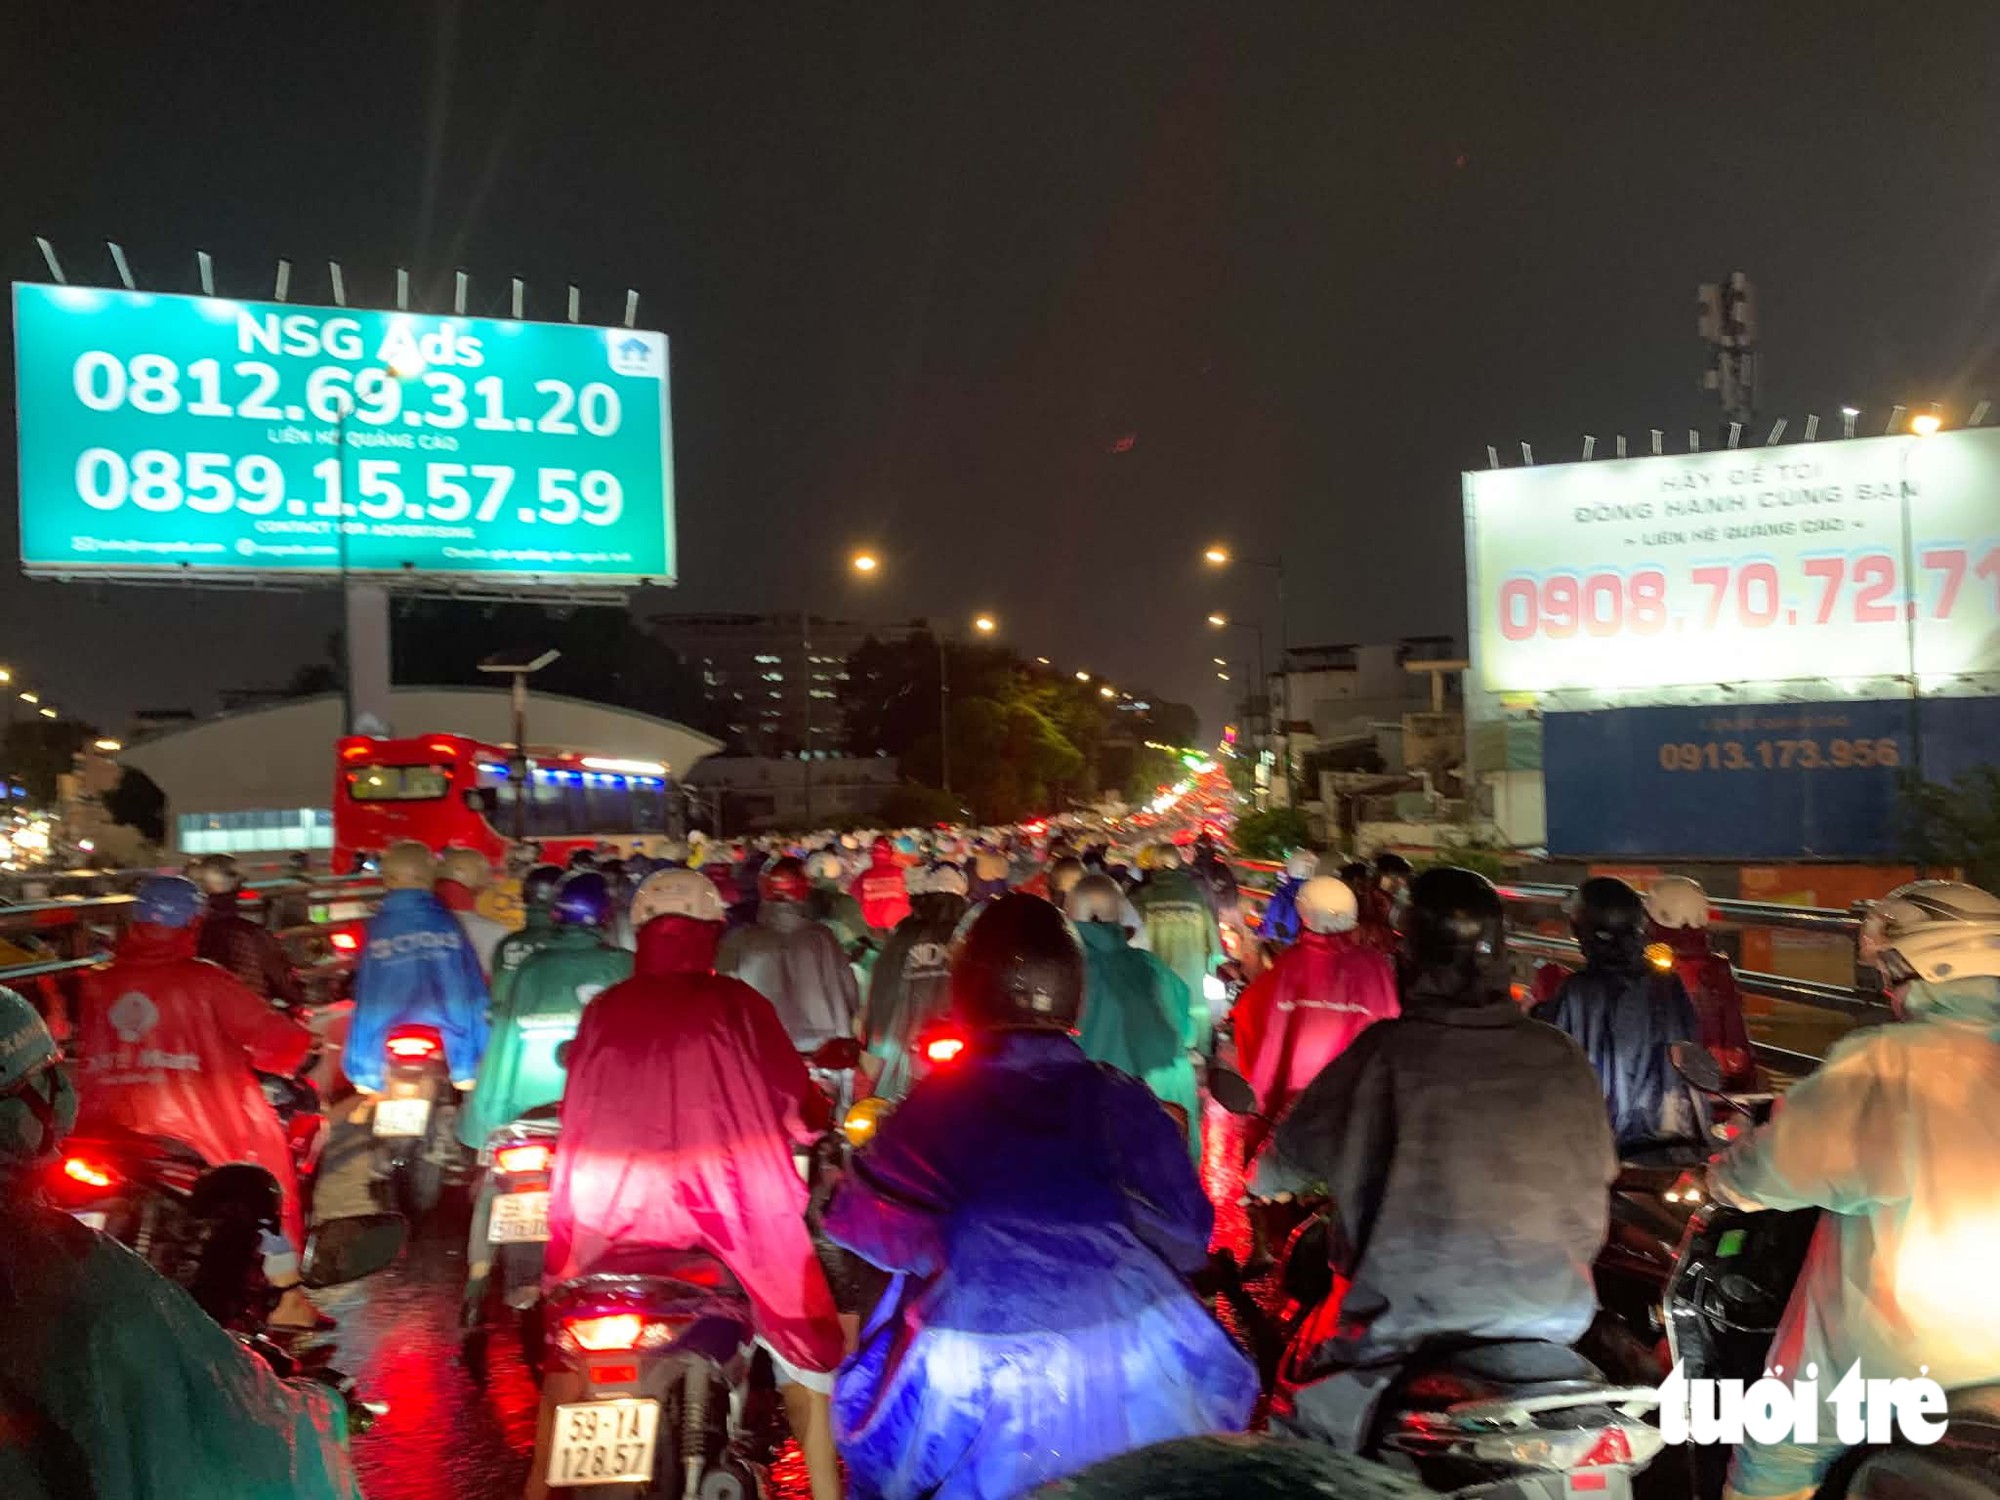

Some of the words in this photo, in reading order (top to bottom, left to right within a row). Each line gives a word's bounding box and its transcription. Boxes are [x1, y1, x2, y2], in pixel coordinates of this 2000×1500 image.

[237, 312, 363, 360] NSG
[376, 317, 485, 367] Ads
[73, 349, 622, 437] 0812.69.31.20
[75, 447, 624, 526] 0859.15.57.59
[1658, 737, 1899, 772] 0913.173.956
